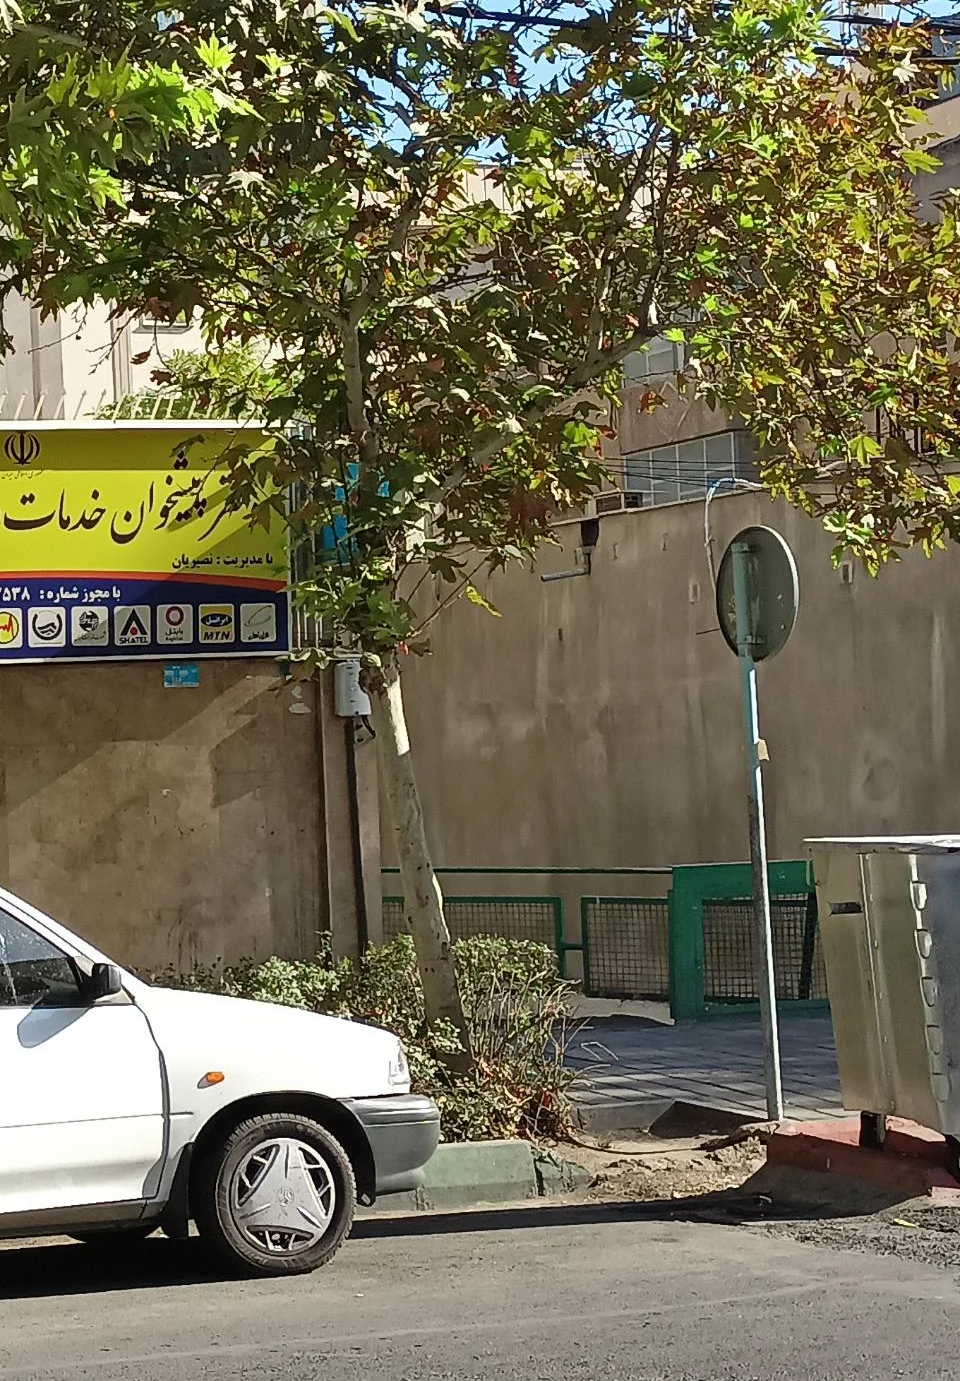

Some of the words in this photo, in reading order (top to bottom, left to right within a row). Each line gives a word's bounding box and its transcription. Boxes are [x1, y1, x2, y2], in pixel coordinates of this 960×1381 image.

[3, 488, 107, 531] خدمات
[172, 553, 213, 569] نصیریان
[223, 555, 263, 569] مدیریت
[82, 590, 110, 603] مجوز
[112, 586, 121, 601] با
[119, 636, 149, 644] SHATEL
[203, 631, 231, 641] MTN
